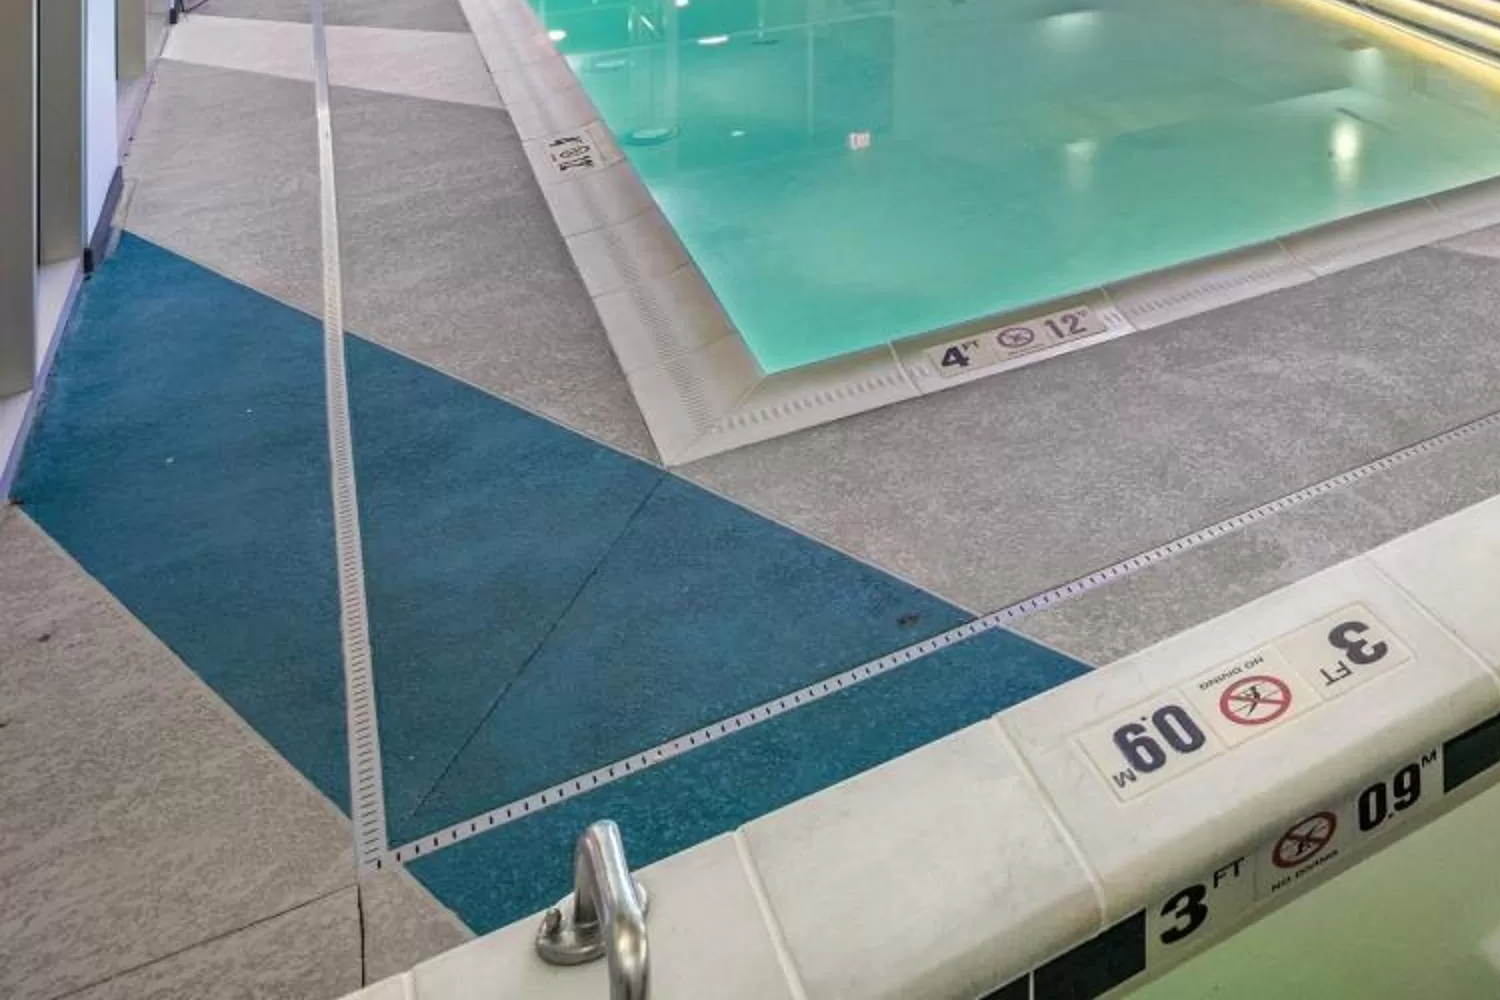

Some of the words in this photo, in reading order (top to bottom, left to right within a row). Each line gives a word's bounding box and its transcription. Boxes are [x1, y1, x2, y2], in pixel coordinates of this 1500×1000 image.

[941, 346, 970, 367] 4
[1328, 620, 1389, 665] 3
[1244, 656, 1265, 670] NO
[1160, 883, 1208, 945] 3
